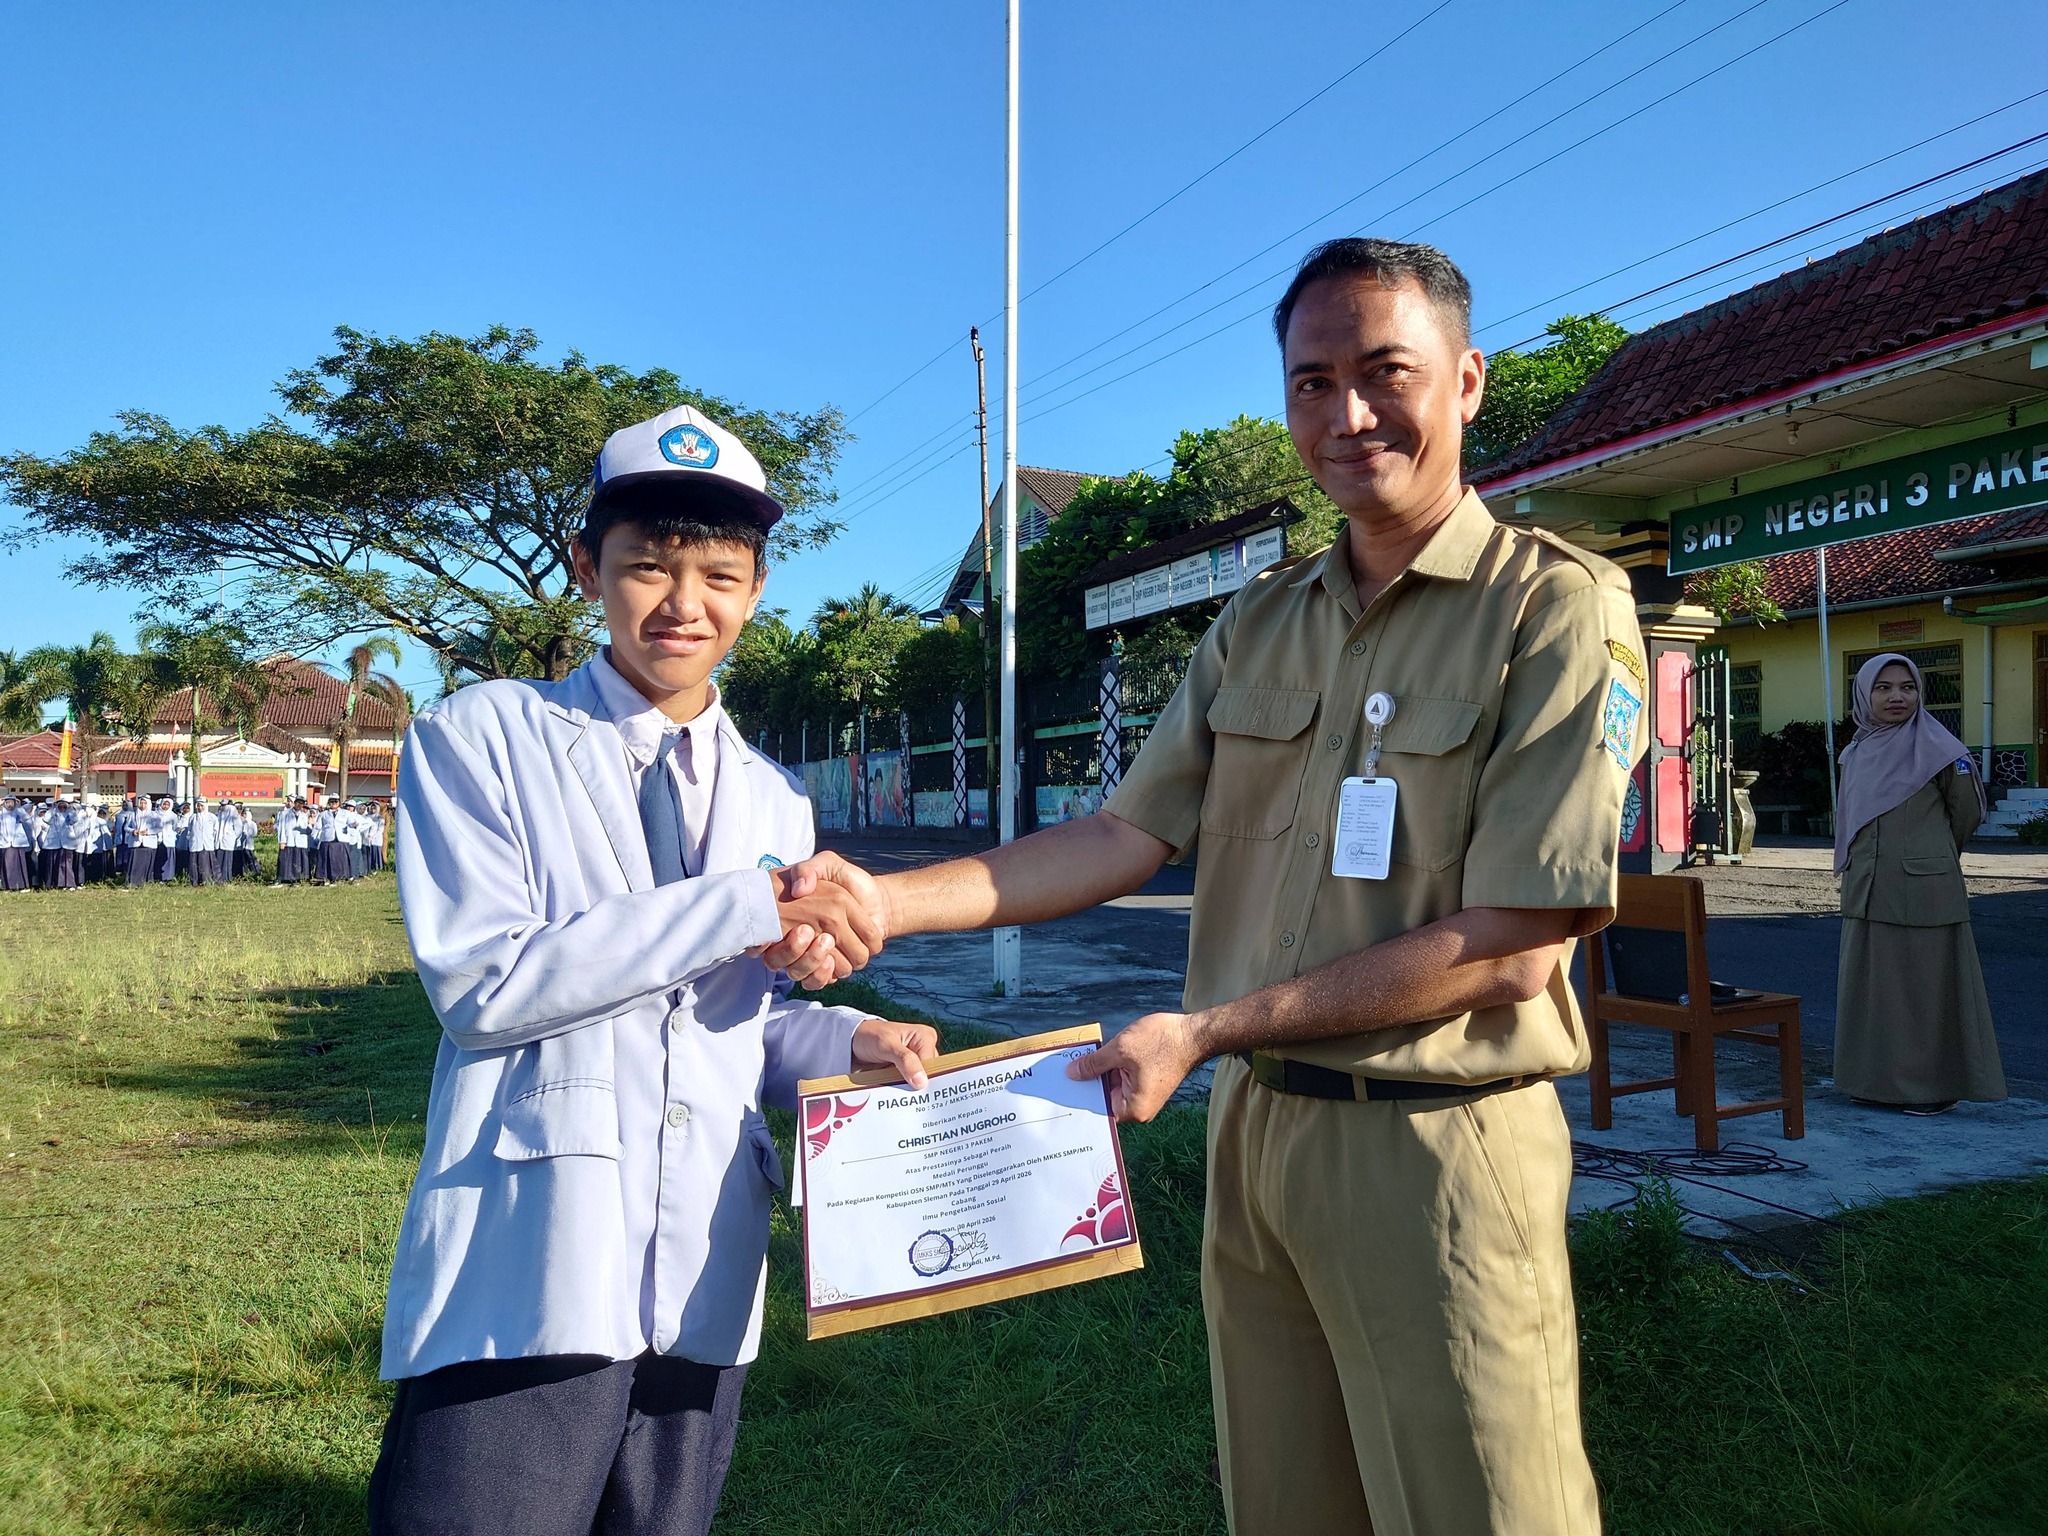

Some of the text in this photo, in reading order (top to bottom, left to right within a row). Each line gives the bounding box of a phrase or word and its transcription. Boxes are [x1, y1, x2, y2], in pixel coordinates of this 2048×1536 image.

[1682, 443, 2048, 553] SMP NEGERI 3 PAKE
[878, 1067, 1033, 1110] PIAGAM PENGHARGAAN
[898, 1112, 1017, 1149] CHRISTIAN NUGROHO
[922, 1115, 957, 1129] Diberikan
[958, 1108, 983, 1120] Kepada
[905, 1143, 1012, 1175] Atas Prestasinya Sebagai Peraih
[923, 1152, 939, 1160] SMP
[940, 1145, 965, 1156] NEGERI
[971, 1136, 994, 1148] PAKEM
[827, 1145, 1094, 1208] Pada Kegiatan Kompetisi OSN SMP/MTs Yang Diselenggarakan Oleh MKKS SMP/MTs
[932, 1161, 989, 1180] Medali Perunggu
[886, 1169, 1033, 1210] Kabupaten Sleman Pada Tanggal 29 April 2026
[951, 1195, 977, 1207] Cabang
[922, 1195, 1007, 1221] Ilmu Pengetahuan Sosial
[966, 1219, 981, 1229] April
[982, 1215, 996, 1224] 2026
